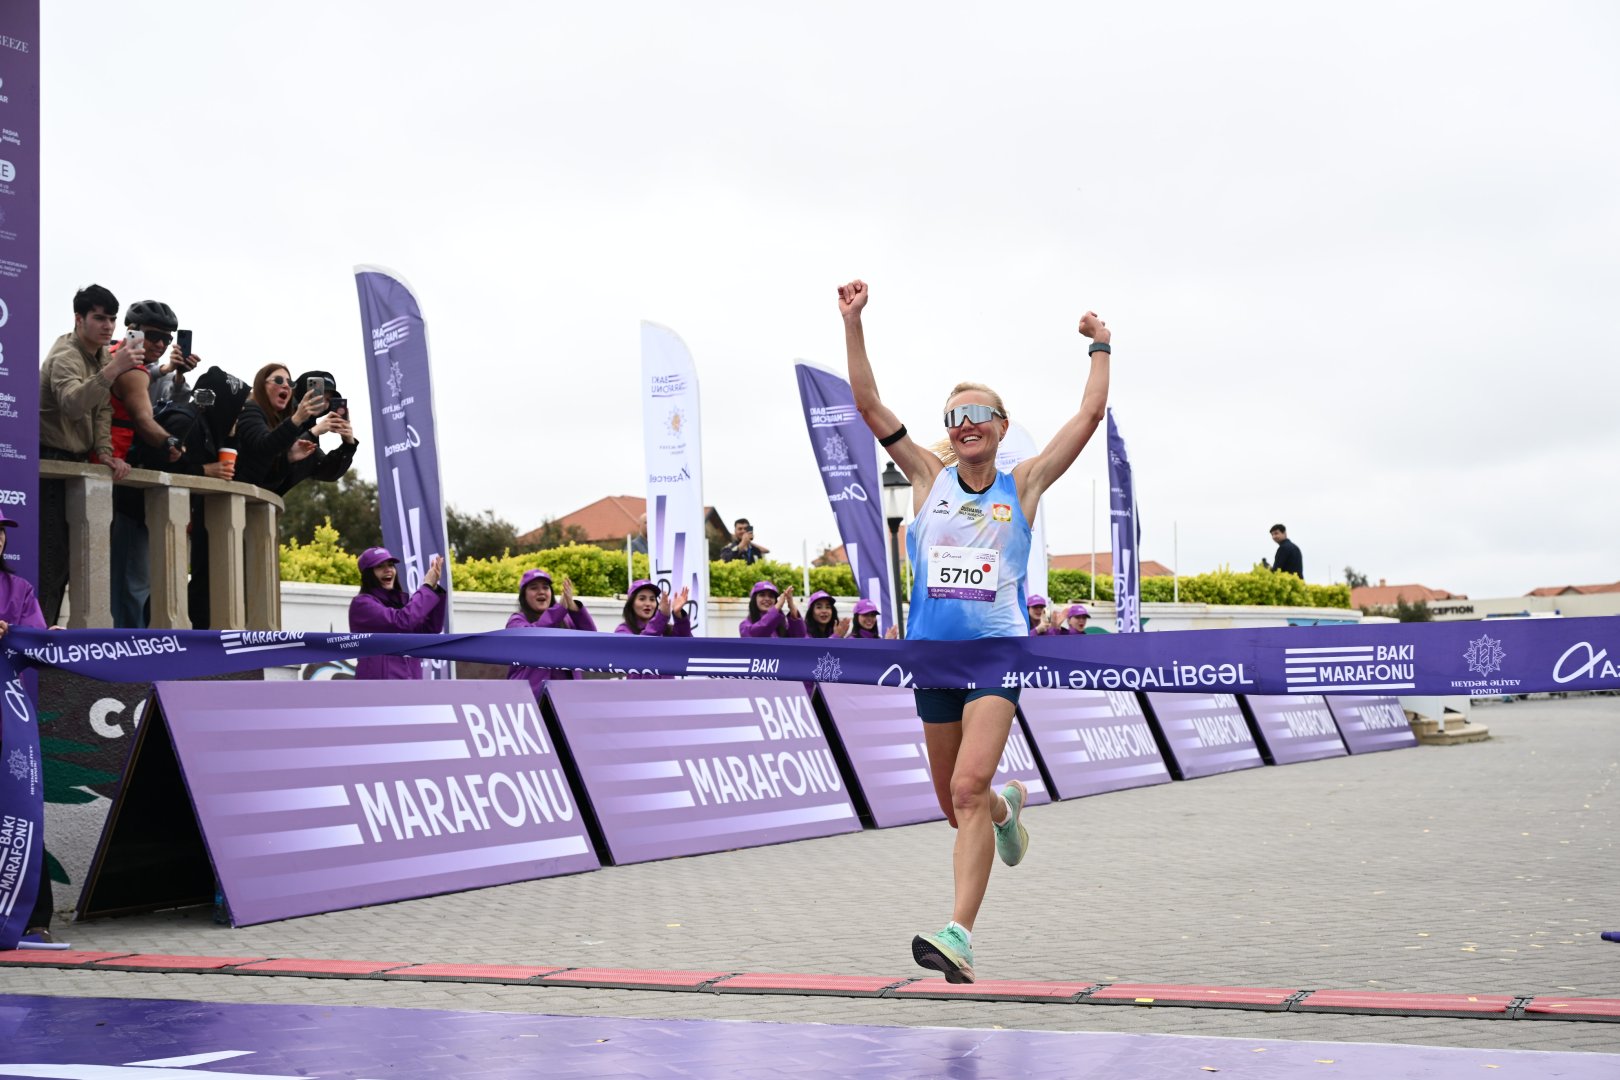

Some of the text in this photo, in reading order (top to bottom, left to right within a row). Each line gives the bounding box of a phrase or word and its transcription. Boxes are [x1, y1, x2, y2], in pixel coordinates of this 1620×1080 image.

[0, 35, 29, 54] EEZE
[940, 567, 984, 586] 5710
[751, 658, 780, 673] BAKI
[1376, 644, 1415, 661] BAKI
[1318, 663, 1415, 683] MARAFONU
[461, 702, 551, 759] BAKI
[754, 695, 822, 741] BAKI
[1193, 714, 1252, 748] MARAFONU
[1079, 722, 1158, 763] MARAFONU
[685, 748, 842, 806] MARAFONU
[354, 768, 575, 844] MARAFONU
[0, 815, 17, 848] BAKI
[0, 818, 28, 890] MARAFONU
